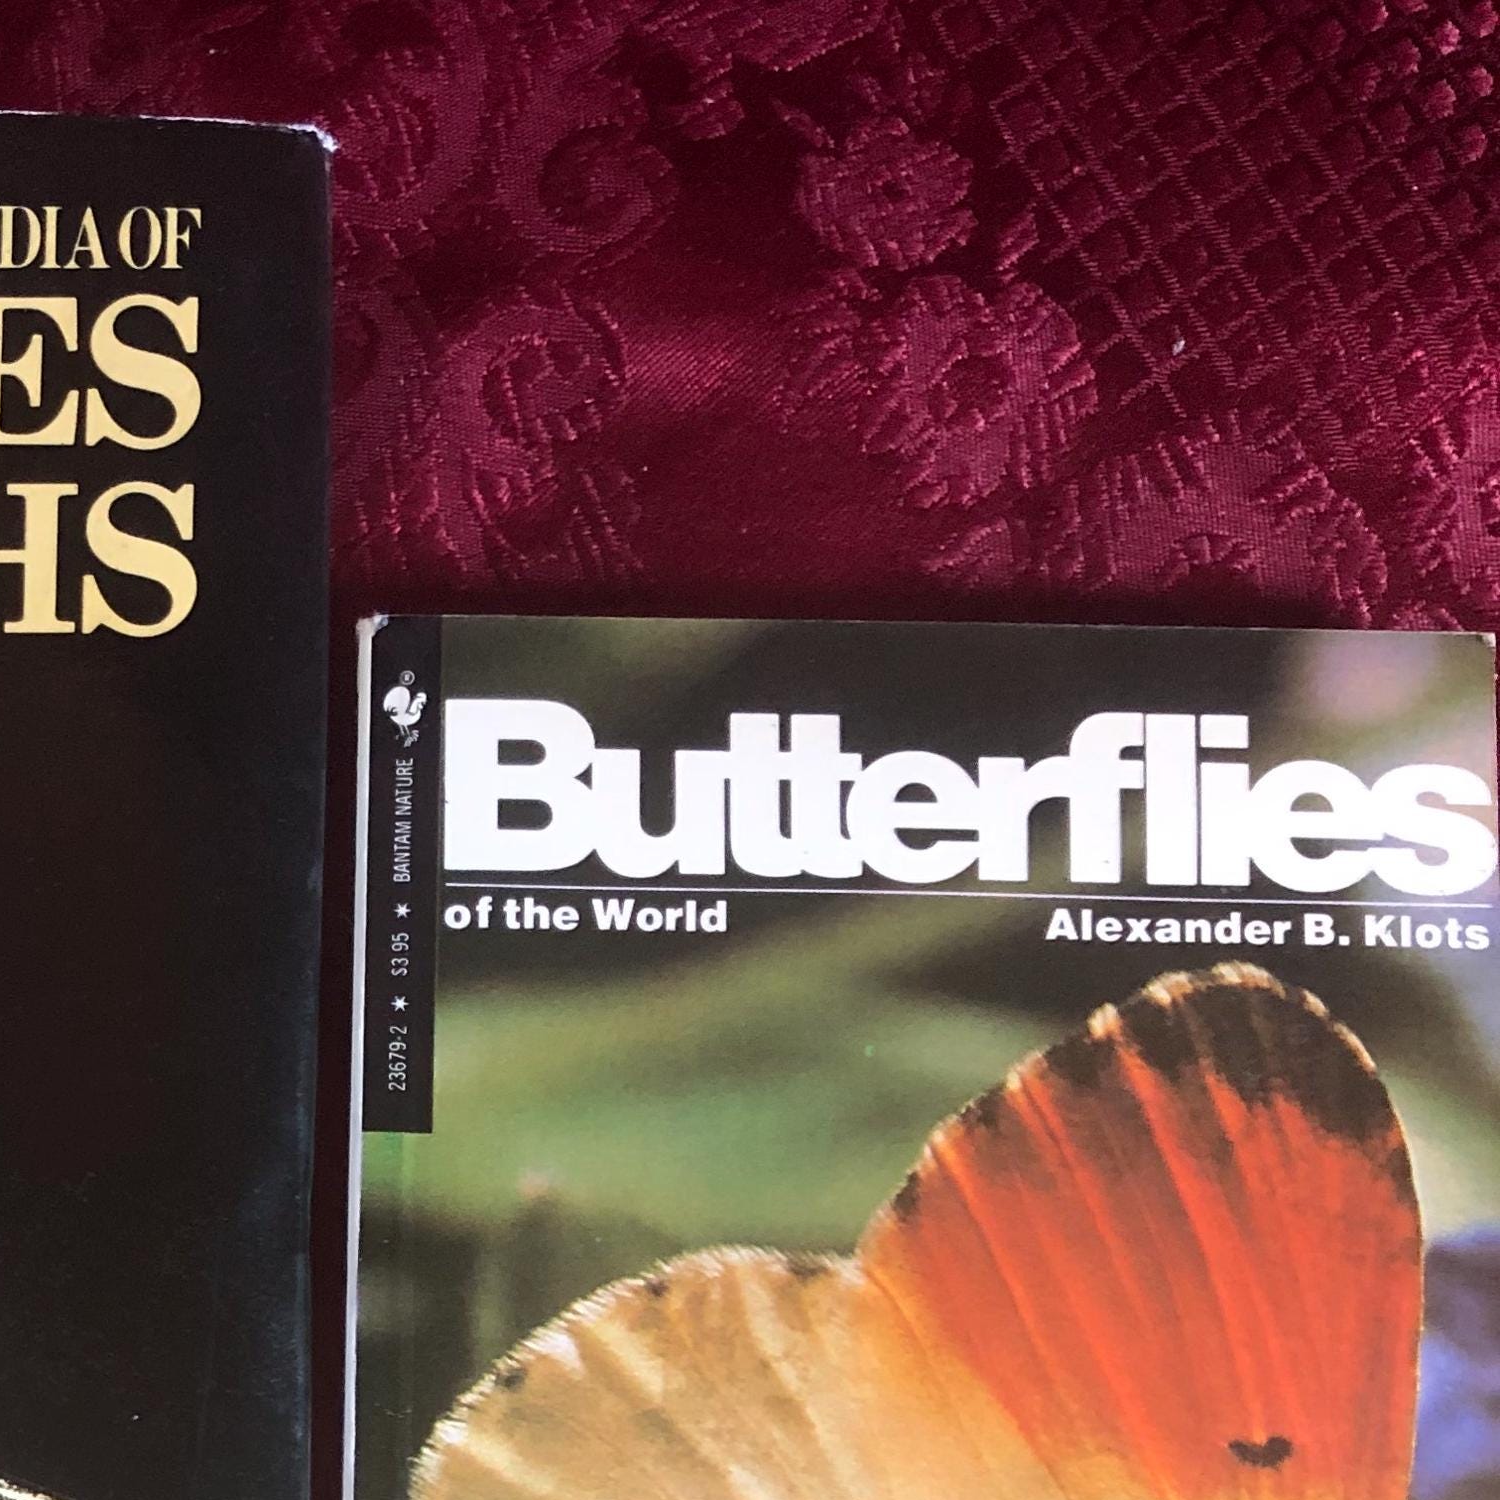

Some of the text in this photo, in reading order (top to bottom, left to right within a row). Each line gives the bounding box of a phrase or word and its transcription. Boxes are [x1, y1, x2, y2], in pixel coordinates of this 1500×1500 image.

[117, 206, 203, 270] OF
[394, 757, 415, 815] NATURE
[443, 698, 1499, 896] Butterflies
[392, 820, 413, 884] BANTAM
[442, 895, 729, 934] of the World
[1043, 906, 1492, 952] Alexander B. Klots
